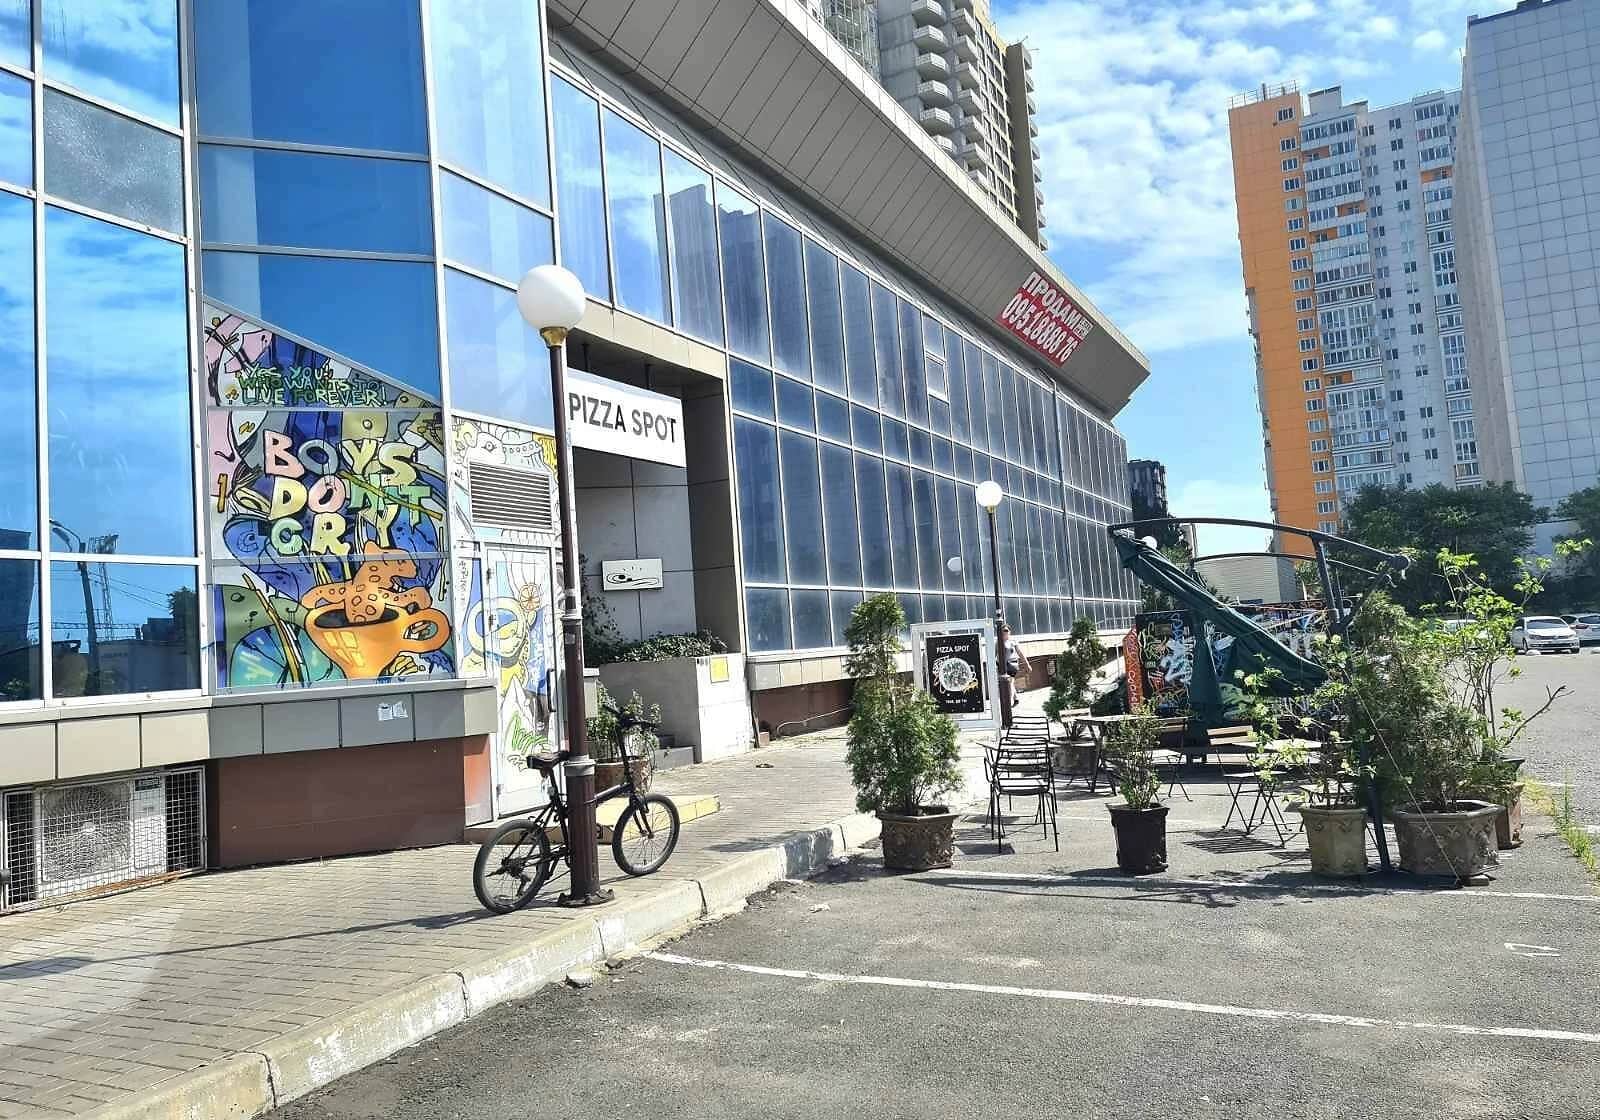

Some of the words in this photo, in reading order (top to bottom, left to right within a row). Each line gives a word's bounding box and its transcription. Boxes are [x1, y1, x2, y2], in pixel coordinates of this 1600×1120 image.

[1022, 271, 1083, 330] ПРОДАМ
[242, 387, 285, 406] LIVE
[284, 377, 350, 391] WANTS
[568, 392, 627, 433] PIZZA
[631, 409, 677, 443] SPOT
[264, 429, 418, 487] BOYS
[270, 503, 400, 556] CRY
[936, 645, 954, 654] PIZZA
